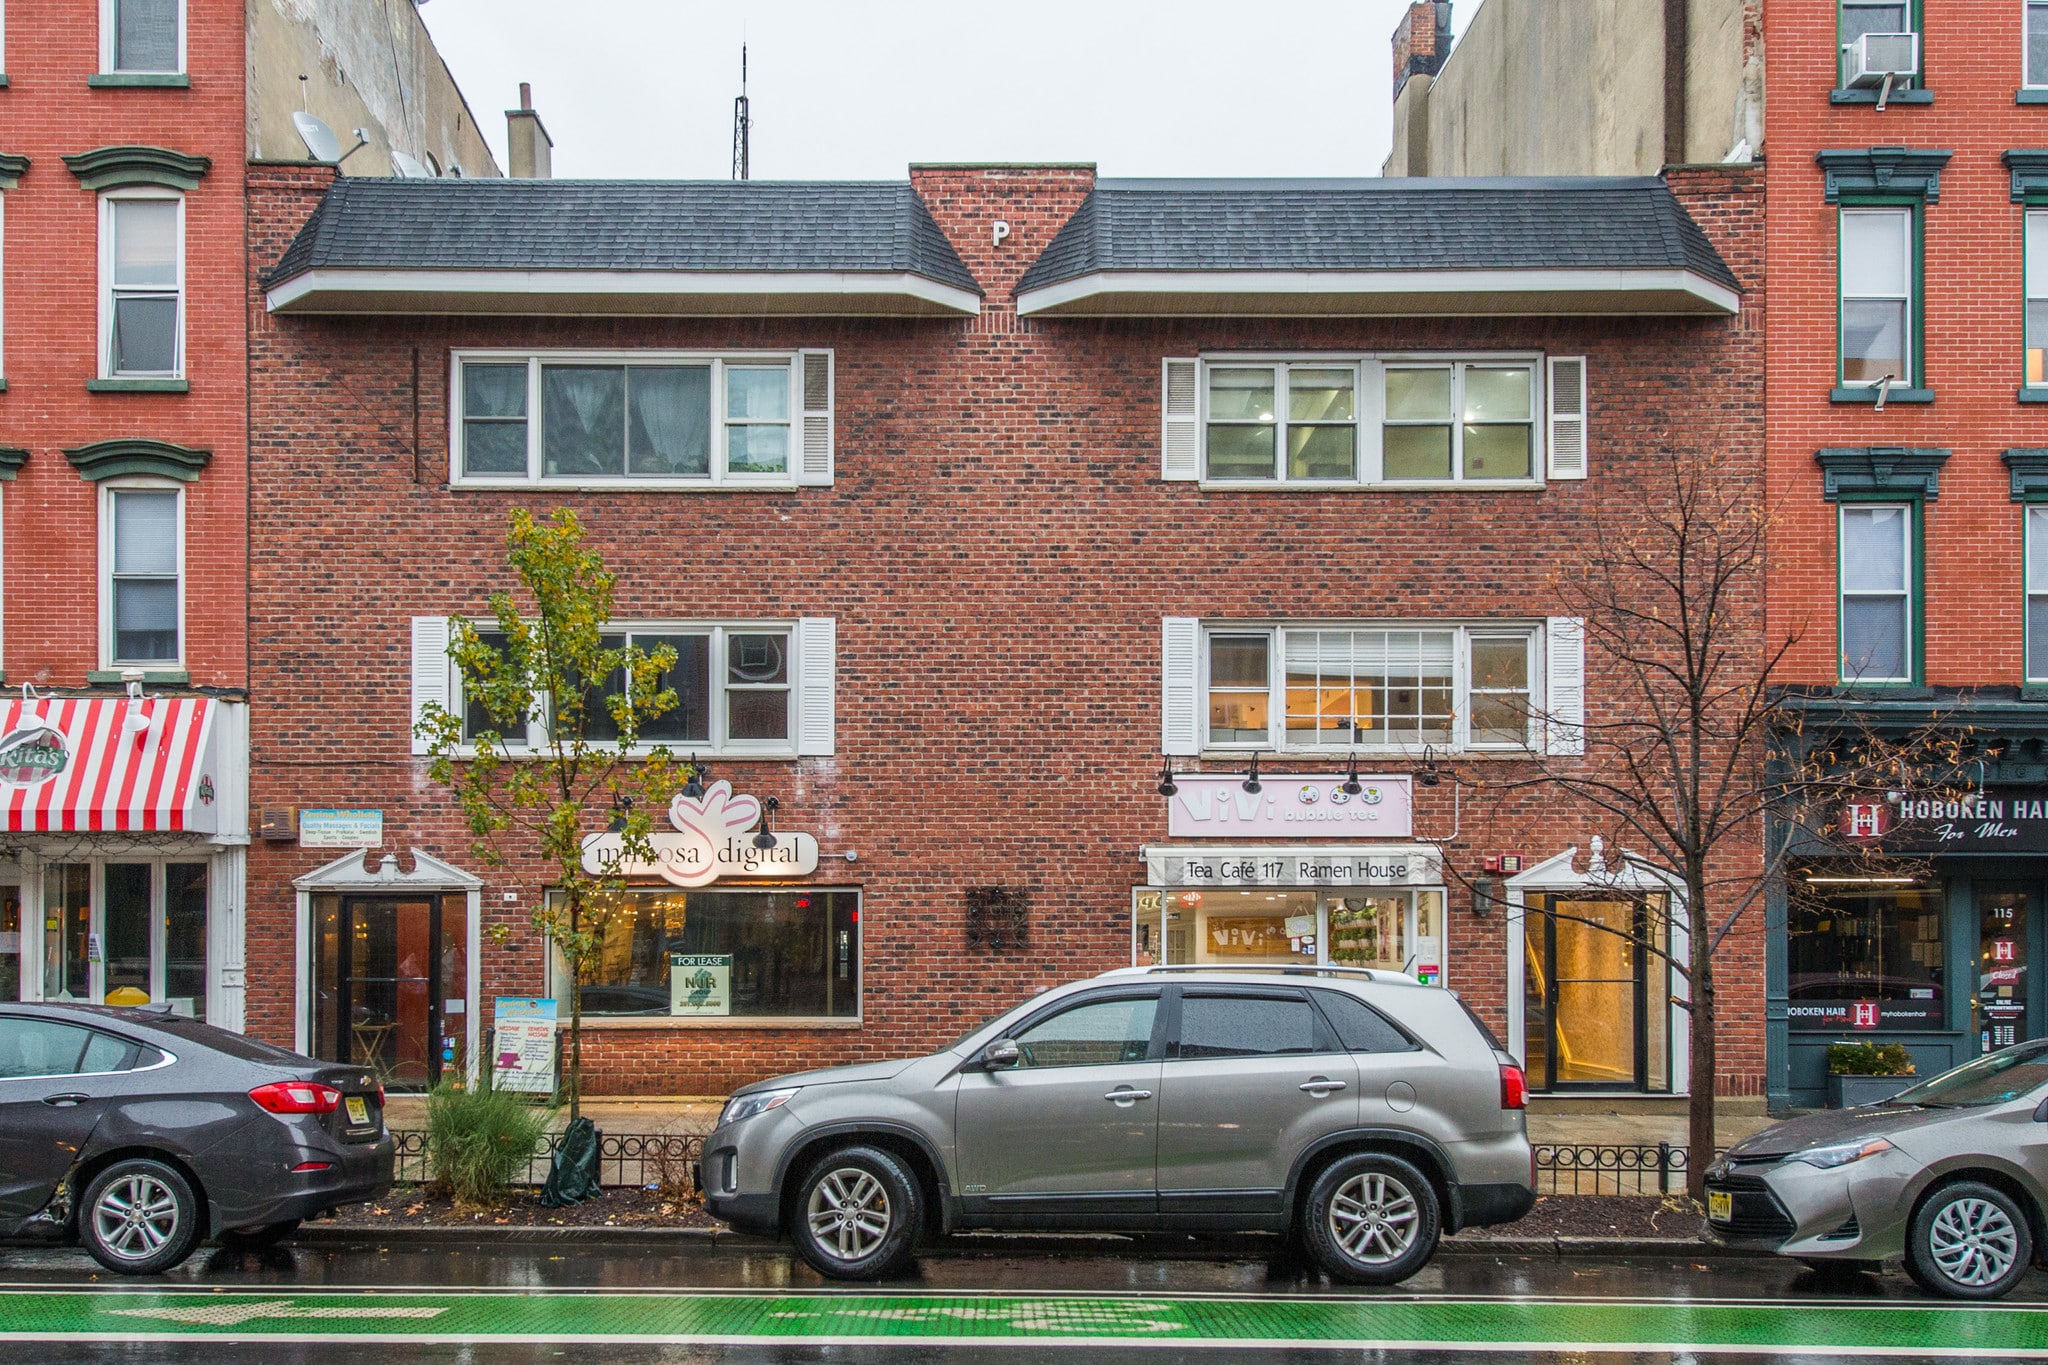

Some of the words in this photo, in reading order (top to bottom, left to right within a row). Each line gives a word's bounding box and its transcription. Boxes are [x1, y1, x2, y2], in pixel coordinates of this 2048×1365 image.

[993, 220, 1010, 247] P
[1284, 807, 1344, 821] bubble
[1349, 808, 1379, 821] tea
[1900, 800, 2004, 819] HOBOKEN
[1933, 823, 1966, 842] For
[1974, 821, 2018, 839] Men
[717, 836, 800, 871] digital
[1187, 862, 1214, 878] Tea
[1220, 861, 1256, 878] Café
[1263, 862, 1284, 878] 117
[1300, 862, 1353, 878] Ramen
[1358, 861, 1407, 878] House
[1994, 908, 2014, 918] 115
[678, 957, 696, 966] FOR
[698, 957, 723, 966] LEASE
[1826, 1007, 1847, 1016] HAIR
